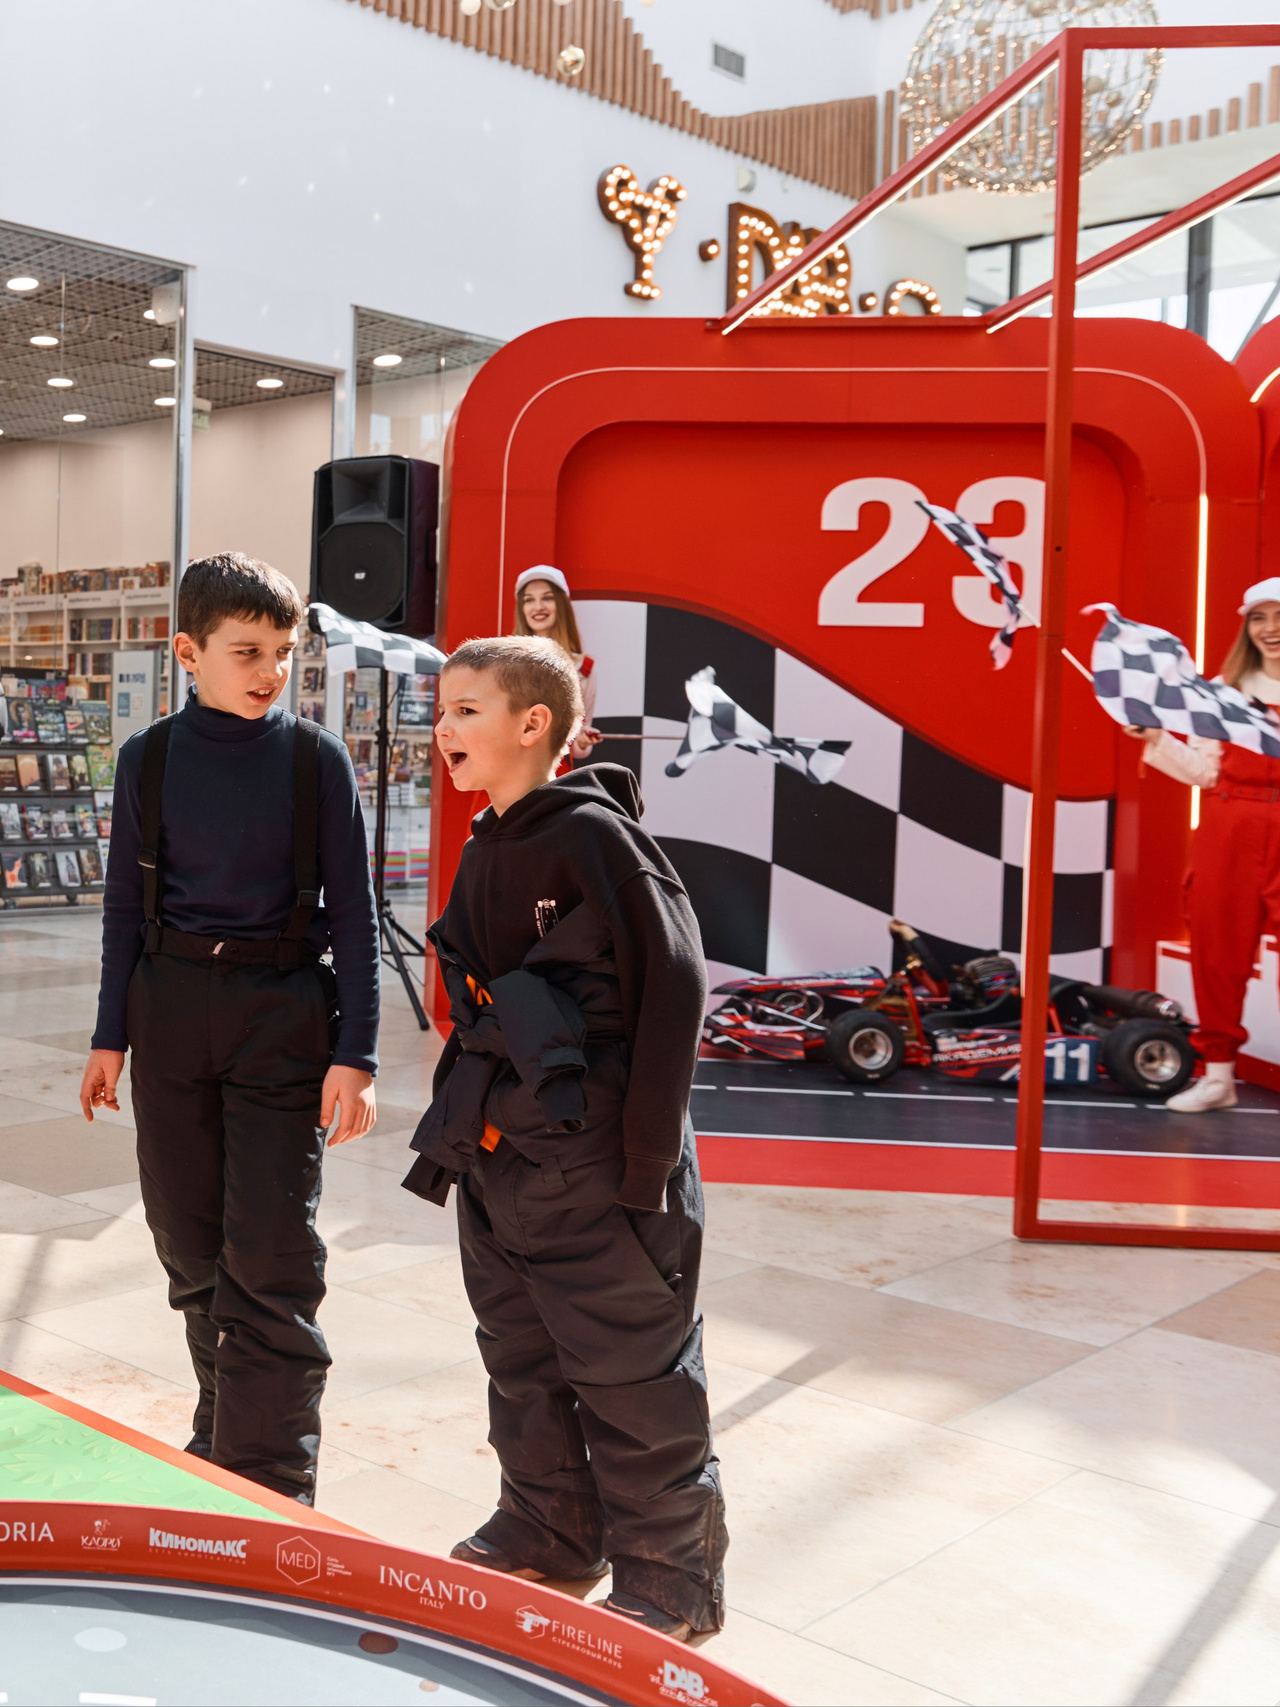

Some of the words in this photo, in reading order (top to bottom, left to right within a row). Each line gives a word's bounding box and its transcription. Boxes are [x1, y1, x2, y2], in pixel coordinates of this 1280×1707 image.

[818, 476, 1046, 628] 23
[1044, 1043, 1090, 1081] 11
[149, 1527, 247, 1559] КИНОМАКС
[281, 1550, 316, 1570] MED
[379, 1565, 487, 1611] INCANTO
[419, 1596, 445, 1610] ITALY
[551, 1620, 623, 1659] FIRELINE
[551, 1636, 602, 1662] СТРЕЛКОВЫЙ
[602, 1655, 623, 1669] КЛУБ
[663, 1659, 705, 1699] DAB
